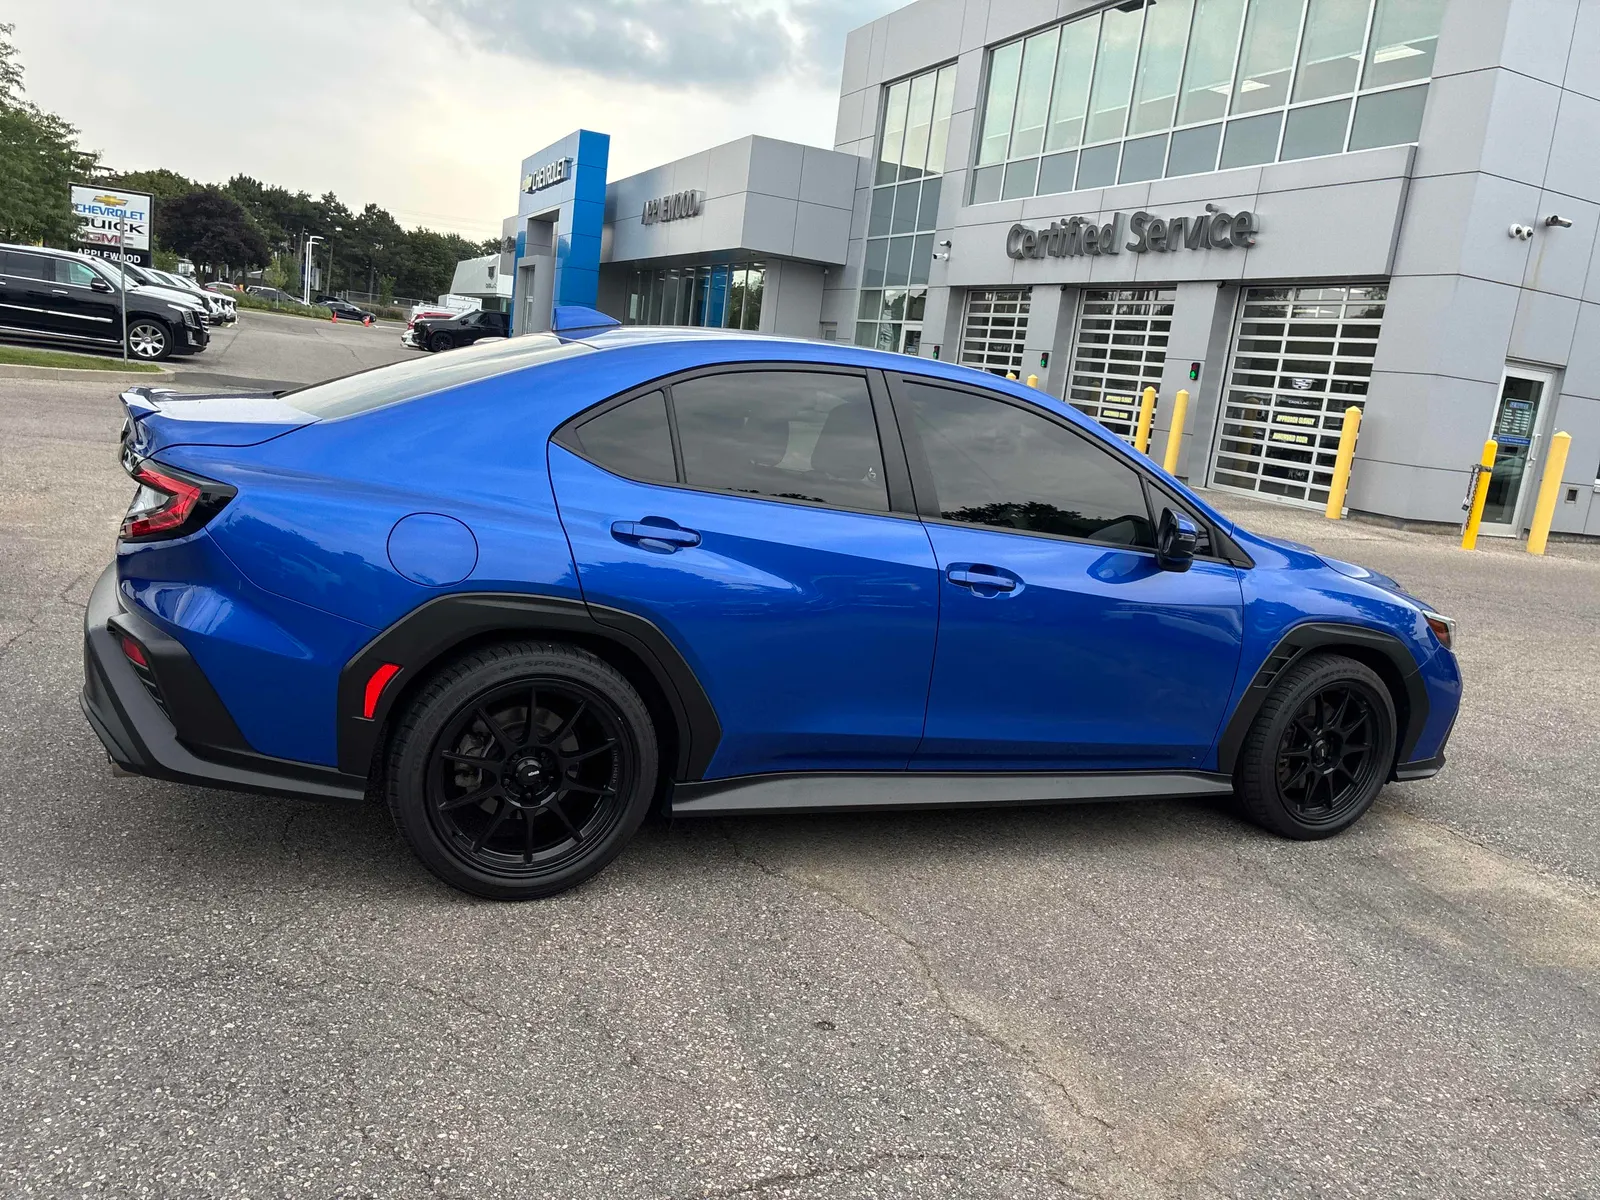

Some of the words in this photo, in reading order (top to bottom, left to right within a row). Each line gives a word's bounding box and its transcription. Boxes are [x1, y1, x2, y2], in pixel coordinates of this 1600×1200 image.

[532, 156, 572, 191] CHEVROLET
[75, 203, 145, 221] CHEVROLET
[641, 189, 704, 225] APPLEWOOD
[1006, 211, 1124, 260] Certified
[1126, 203, 1258, 253] Service
